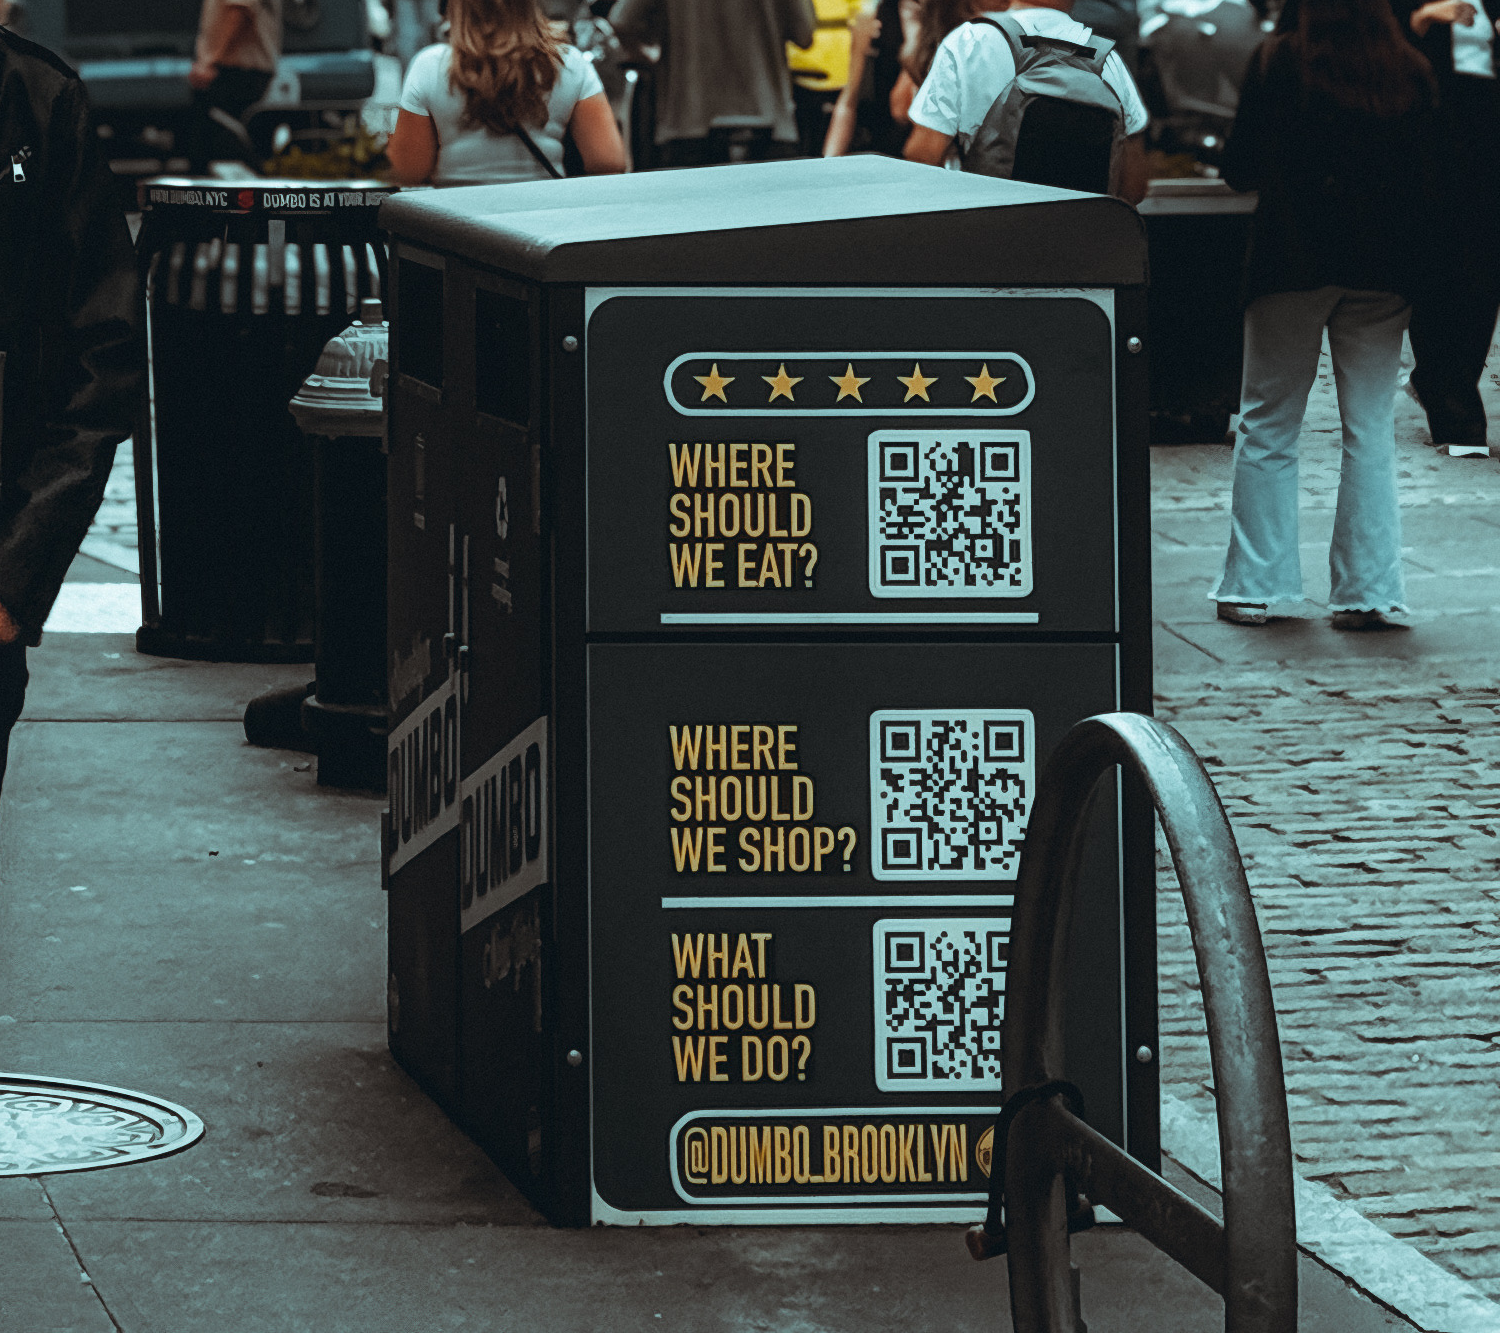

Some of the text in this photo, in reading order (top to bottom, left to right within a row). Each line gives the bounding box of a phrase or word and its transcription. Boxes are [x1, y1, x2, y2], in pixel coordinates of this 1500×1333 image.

[263, 193, 306, 208] DUMBO
[309, 193, 320, 207] IS
[323, 192, 335, 207] AT
[669, 443, 795, 487] WHERE
[670, 493, 811, 537] SHOULD
[670, 543, 817, 587] WE EAT?
[670, 725, 797, 770] WHERE
[389, 693, 457, 856] DUMBO
[671, 776, 813, 821] SHOULD
[462, 741, 541, 911] DUMBO
[671, 827, 856, 872] WE SHOP?
[673, 933, 772, 978] WHAT
[673, 984, 815, 1030] SHOULD
[672, 1035, 810, 1081] WE DO?
[685, 1124, 967, 1184] @DUMBO_BROOKLYN
